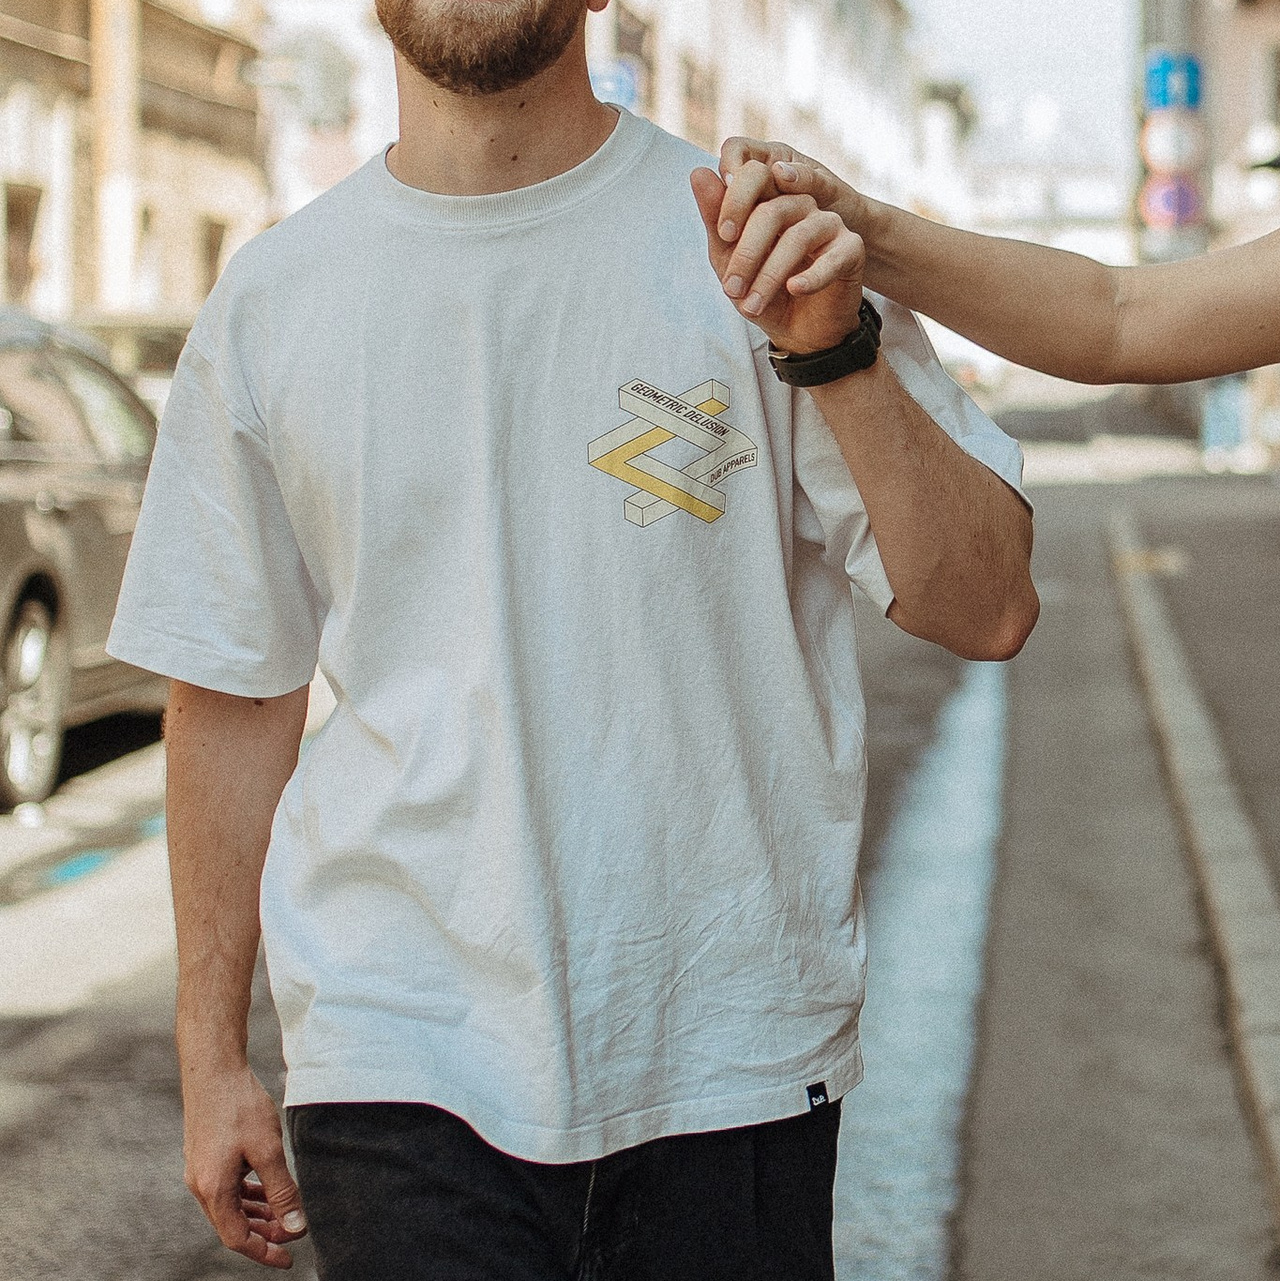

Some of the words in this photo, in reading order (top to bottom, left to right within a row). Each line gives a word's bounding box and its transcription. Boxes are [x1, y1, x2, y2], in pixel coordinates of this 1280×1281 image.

[631, 383, 688, 414] GEOMETRIC
[683, 410, 730, 437] DELUSION
[723, 453, 755, 474] APPARELS
